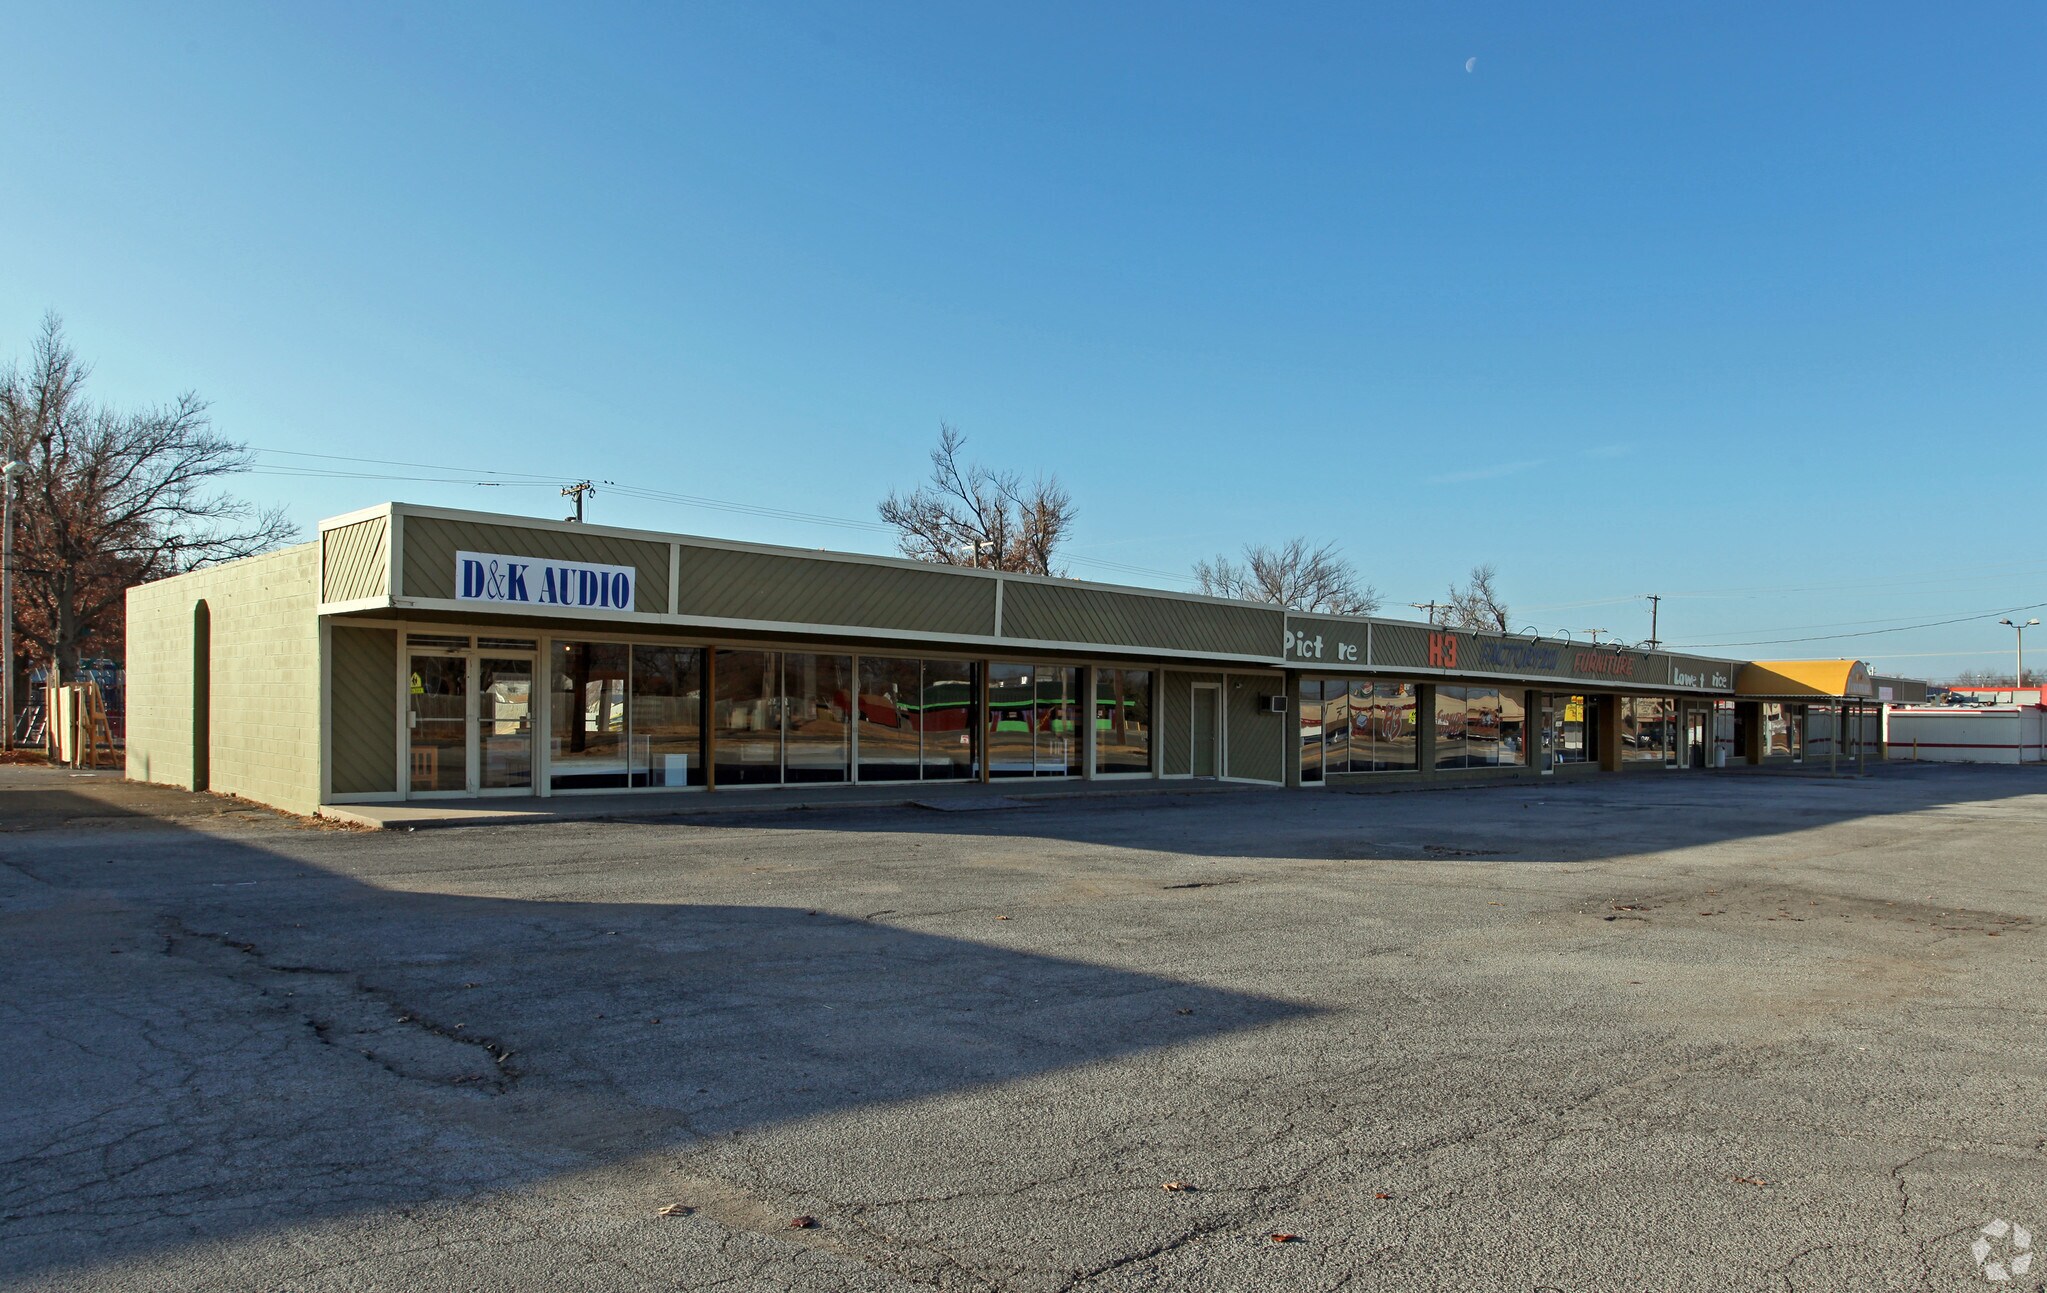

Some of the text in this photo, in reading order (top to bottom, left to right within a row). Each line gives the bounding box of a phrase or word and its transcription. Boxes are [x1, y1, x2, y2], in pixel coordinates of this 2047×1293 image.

[461, 559, 630, 609] D&K AUDIO
[1428, 632, 1457, 668] H3
[1573, 651, 1635, 676] FURNITURE
